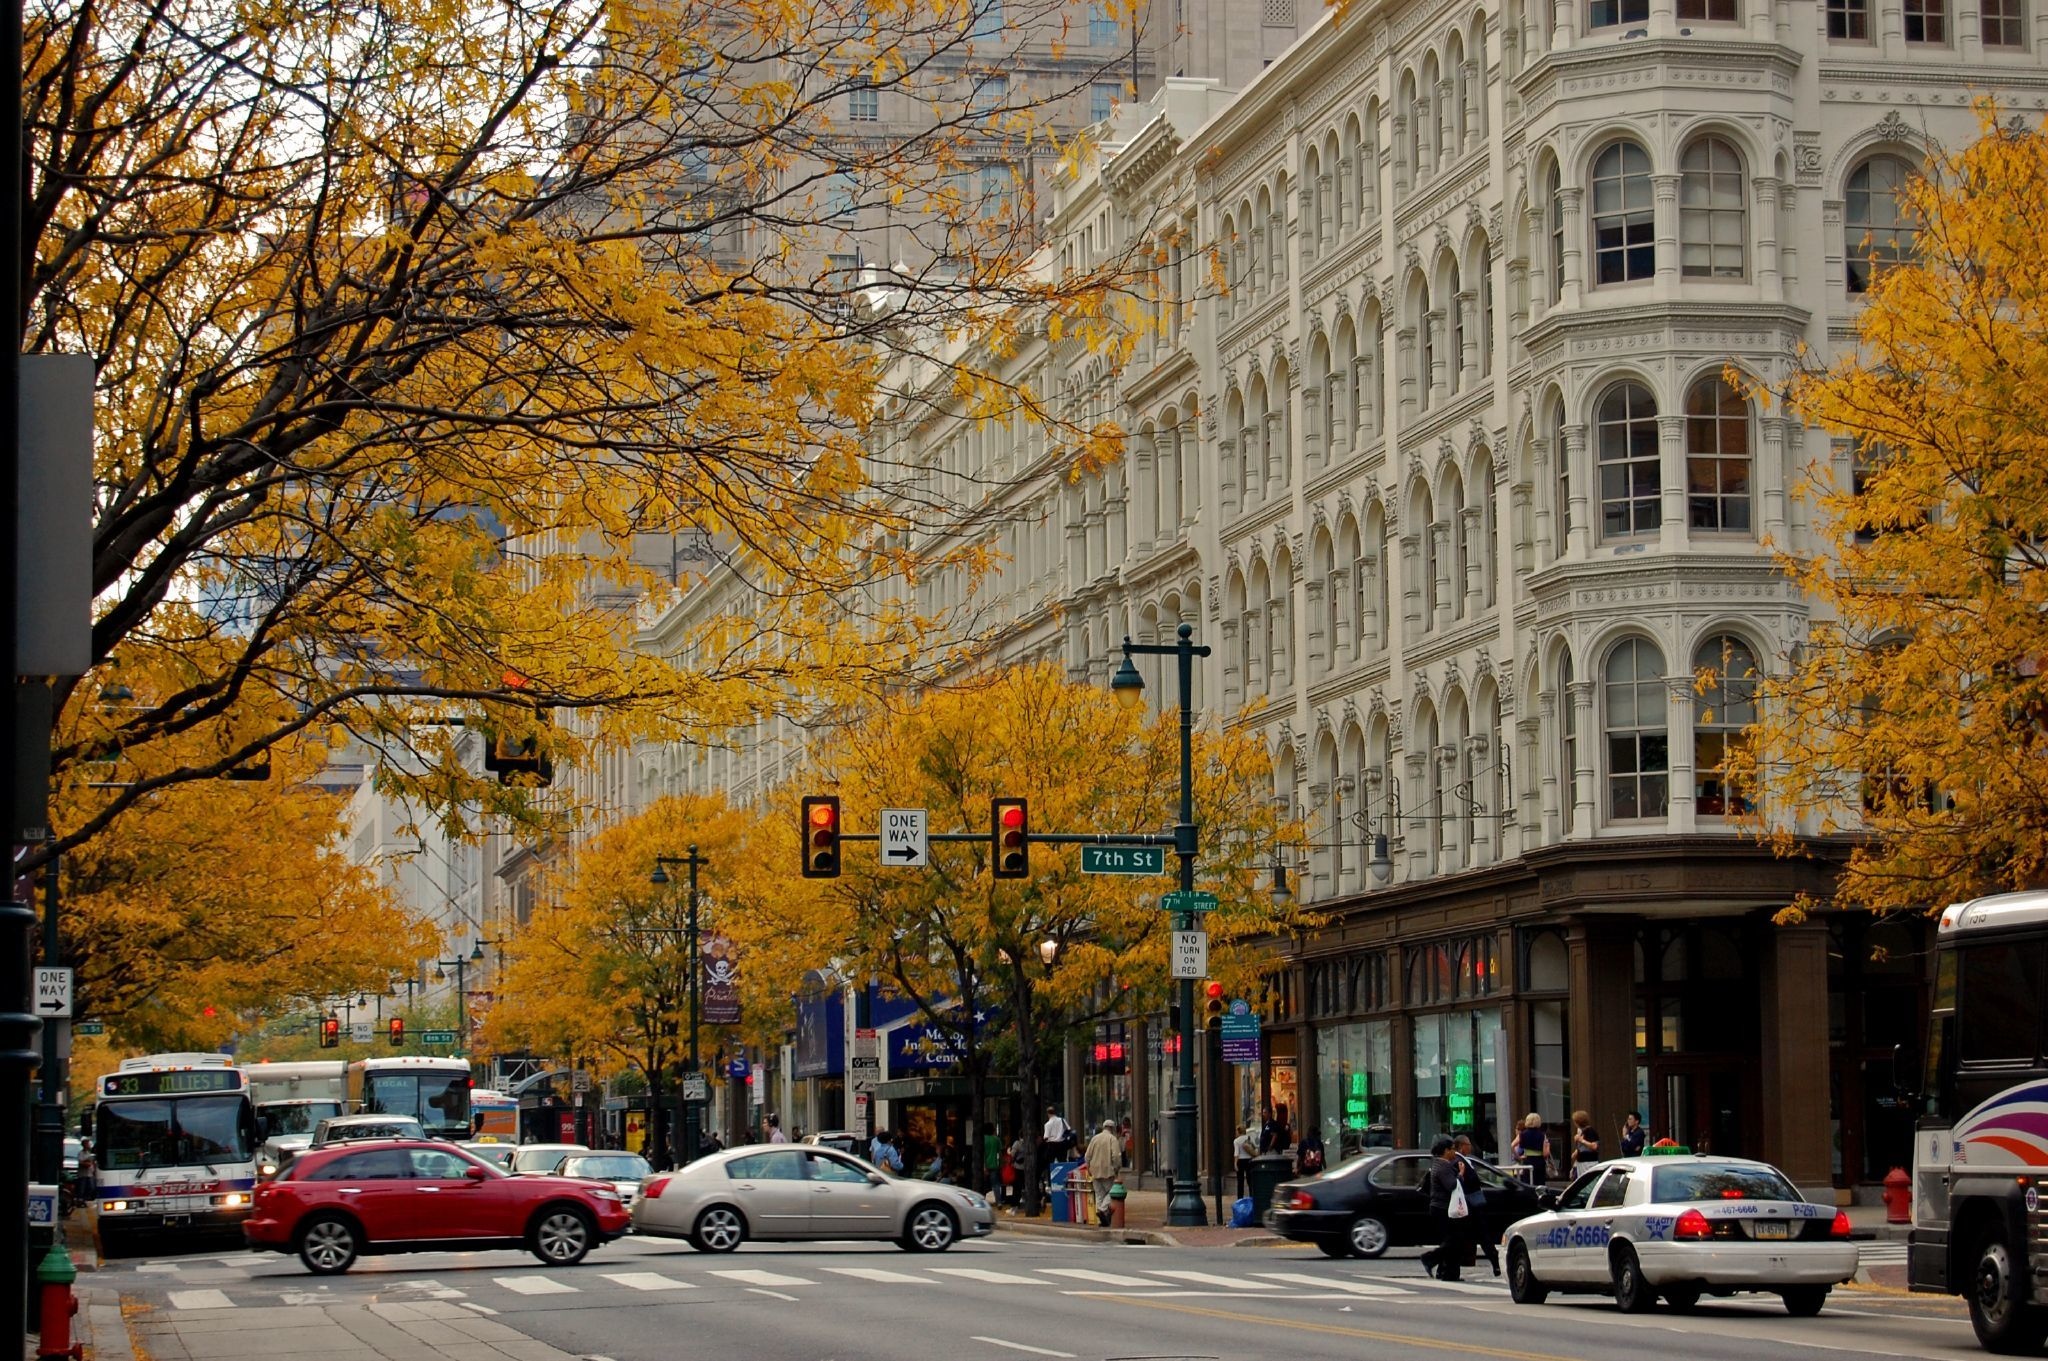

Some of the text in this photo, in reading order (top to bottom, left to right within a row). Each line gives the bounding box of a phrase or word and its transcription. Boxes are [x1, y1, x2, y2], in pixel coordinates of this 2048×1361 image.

[889, 814, 918, 828] ONE
[889, 829, 919, 843] WAY
[1093, 851, 1152, 867] 7th St
[1606, 873, 1652, 890] LITS
[1193, 902, 1217, 910] STREET
[1181, 935, 1198, 945] NO
[1178, 946, 1200, 955] TURN
[1181, 966, 1198, 975] RED
[40, 971, 67, 983] ONE
[39, 985, 67, 996] WAY
[357, 1025, 368, 1033] NO
[925, 1053, 968, 1063] Cente
[120, 1078, 139, 1094] 33
[376, 1080, 409, 1088] LOCAL
[574, 1081, 589, 1090] 25
[1547, 1226, 1610, 1249] 467-6666
